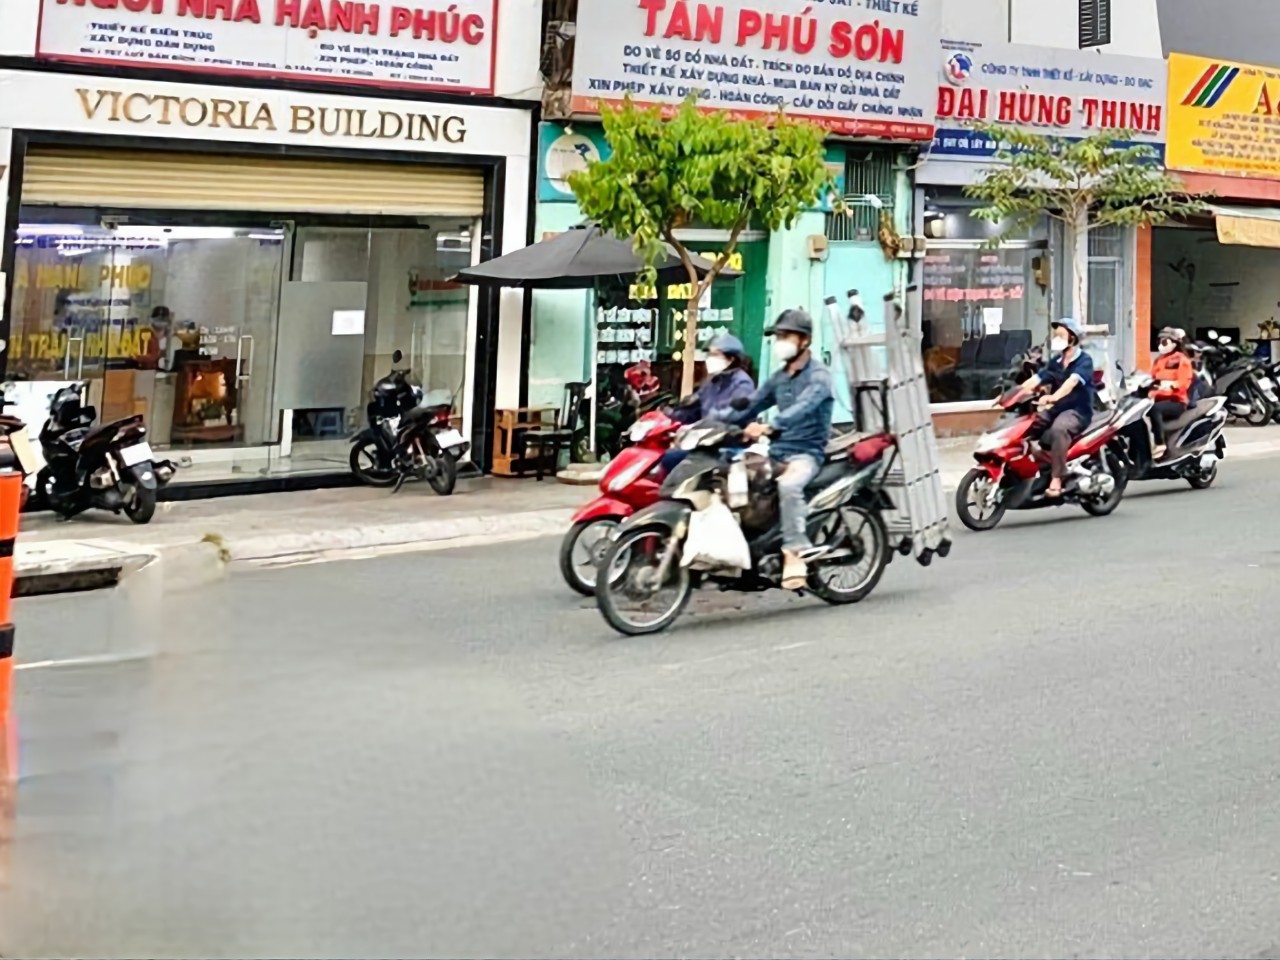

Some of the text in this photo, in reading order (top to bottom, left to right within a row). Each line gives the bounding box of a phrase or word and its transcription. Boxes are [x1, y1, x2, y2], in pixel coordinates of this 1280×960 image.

[390, 4, 485, 46] PHÚC
[736, 5, 818, 55] PHÚ
[827, 18, 905, 65] SƠN
[587, 77, 611, 91] XIN
[75, 87, 468, 144] VICTORIA BUILDING
